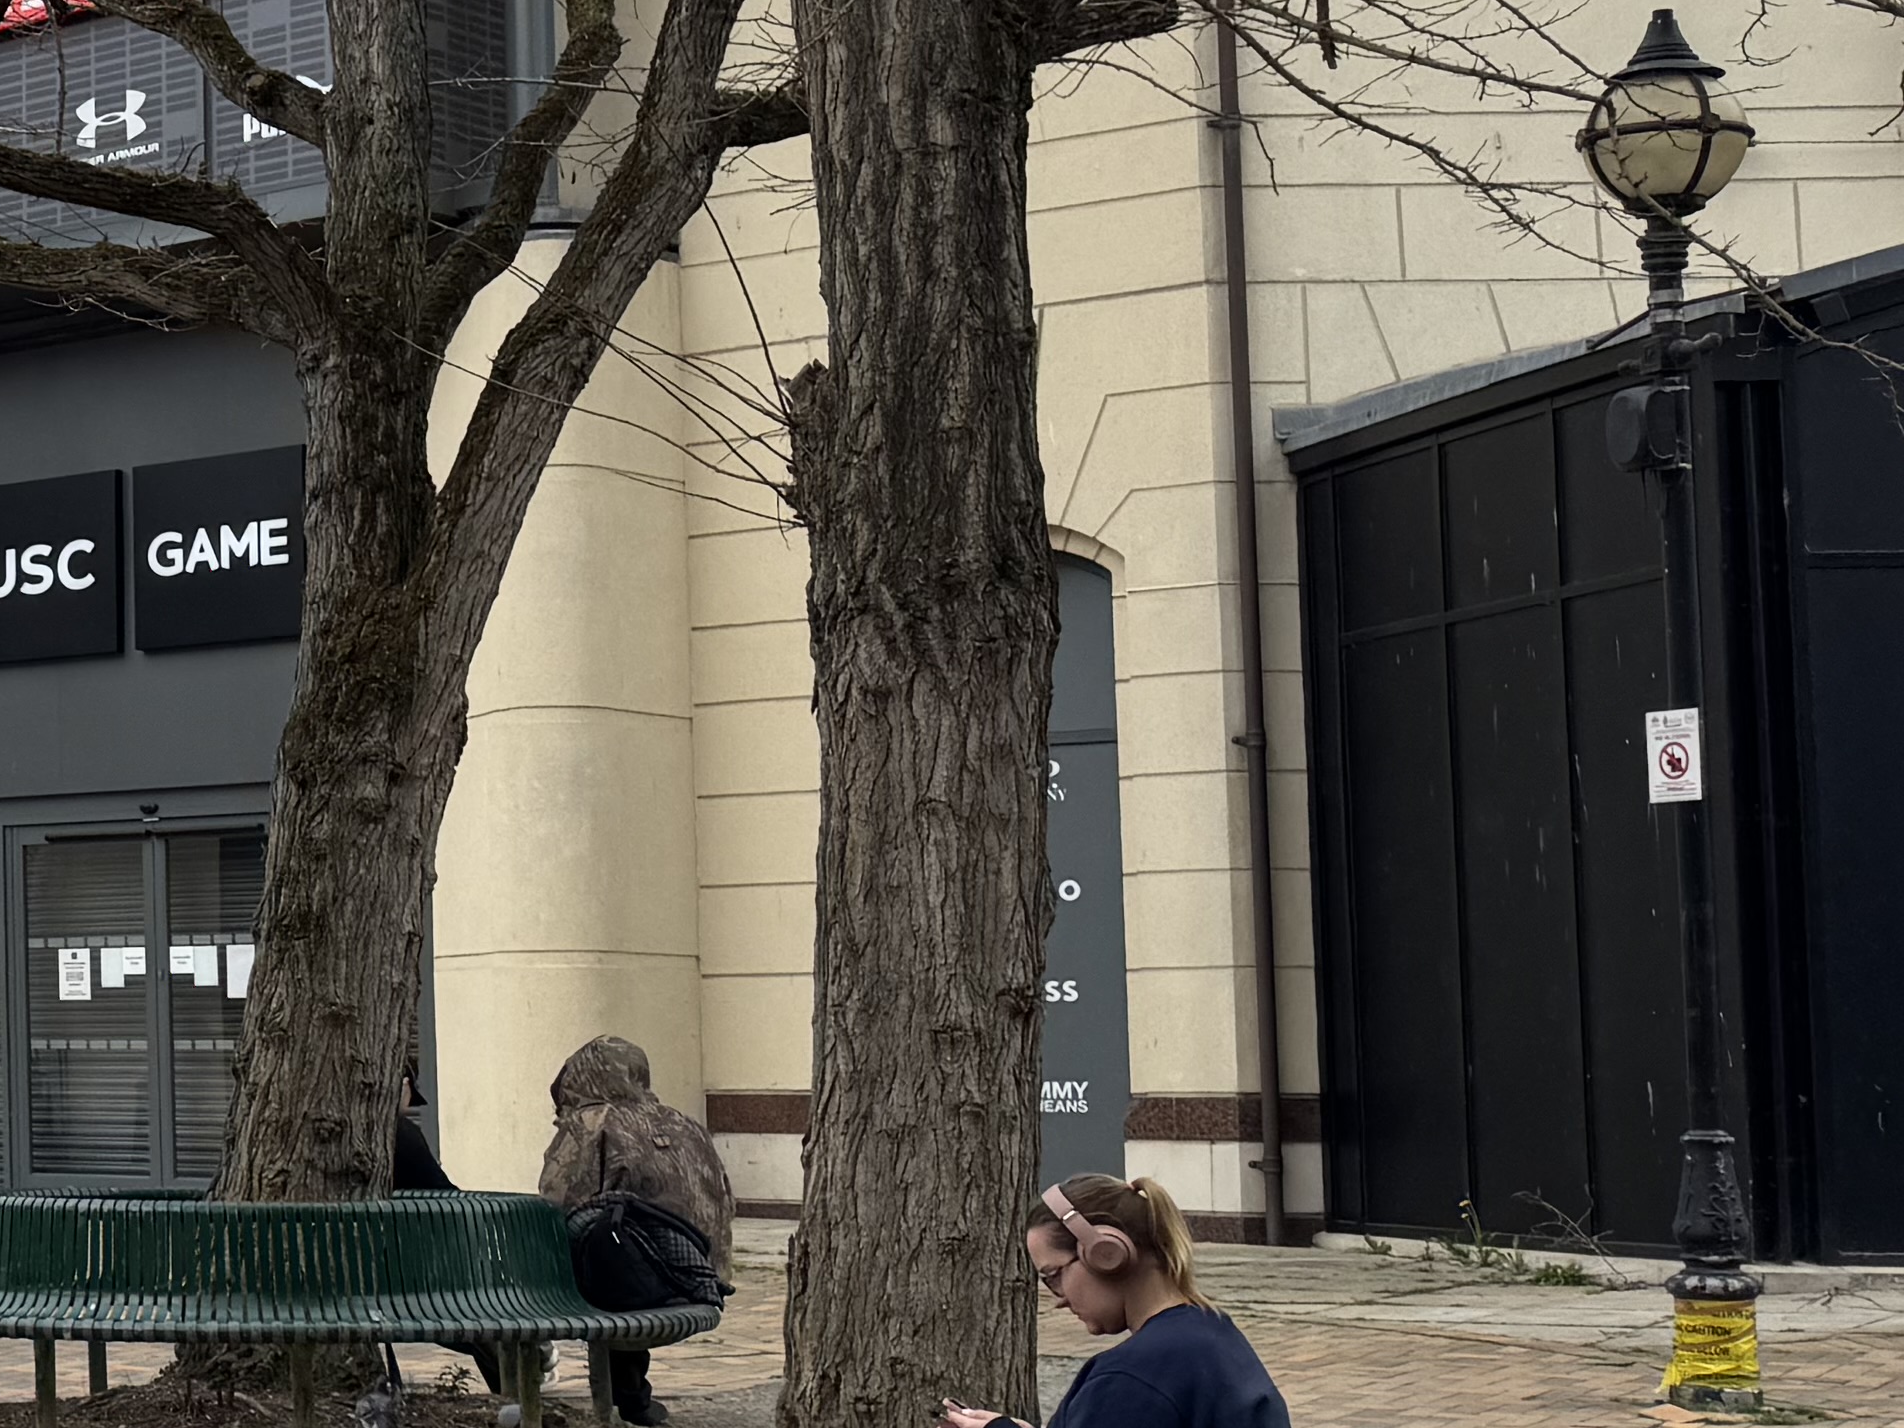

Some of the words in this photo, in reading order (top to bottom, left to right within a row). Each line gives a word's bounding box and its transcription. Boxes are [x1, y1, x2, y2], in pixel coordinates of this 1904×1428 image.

[147, 518, 289, 577] GAME
[1045, 980, 1078, 1002] SS
[1041, 1081, 1088, 1099] MMY
